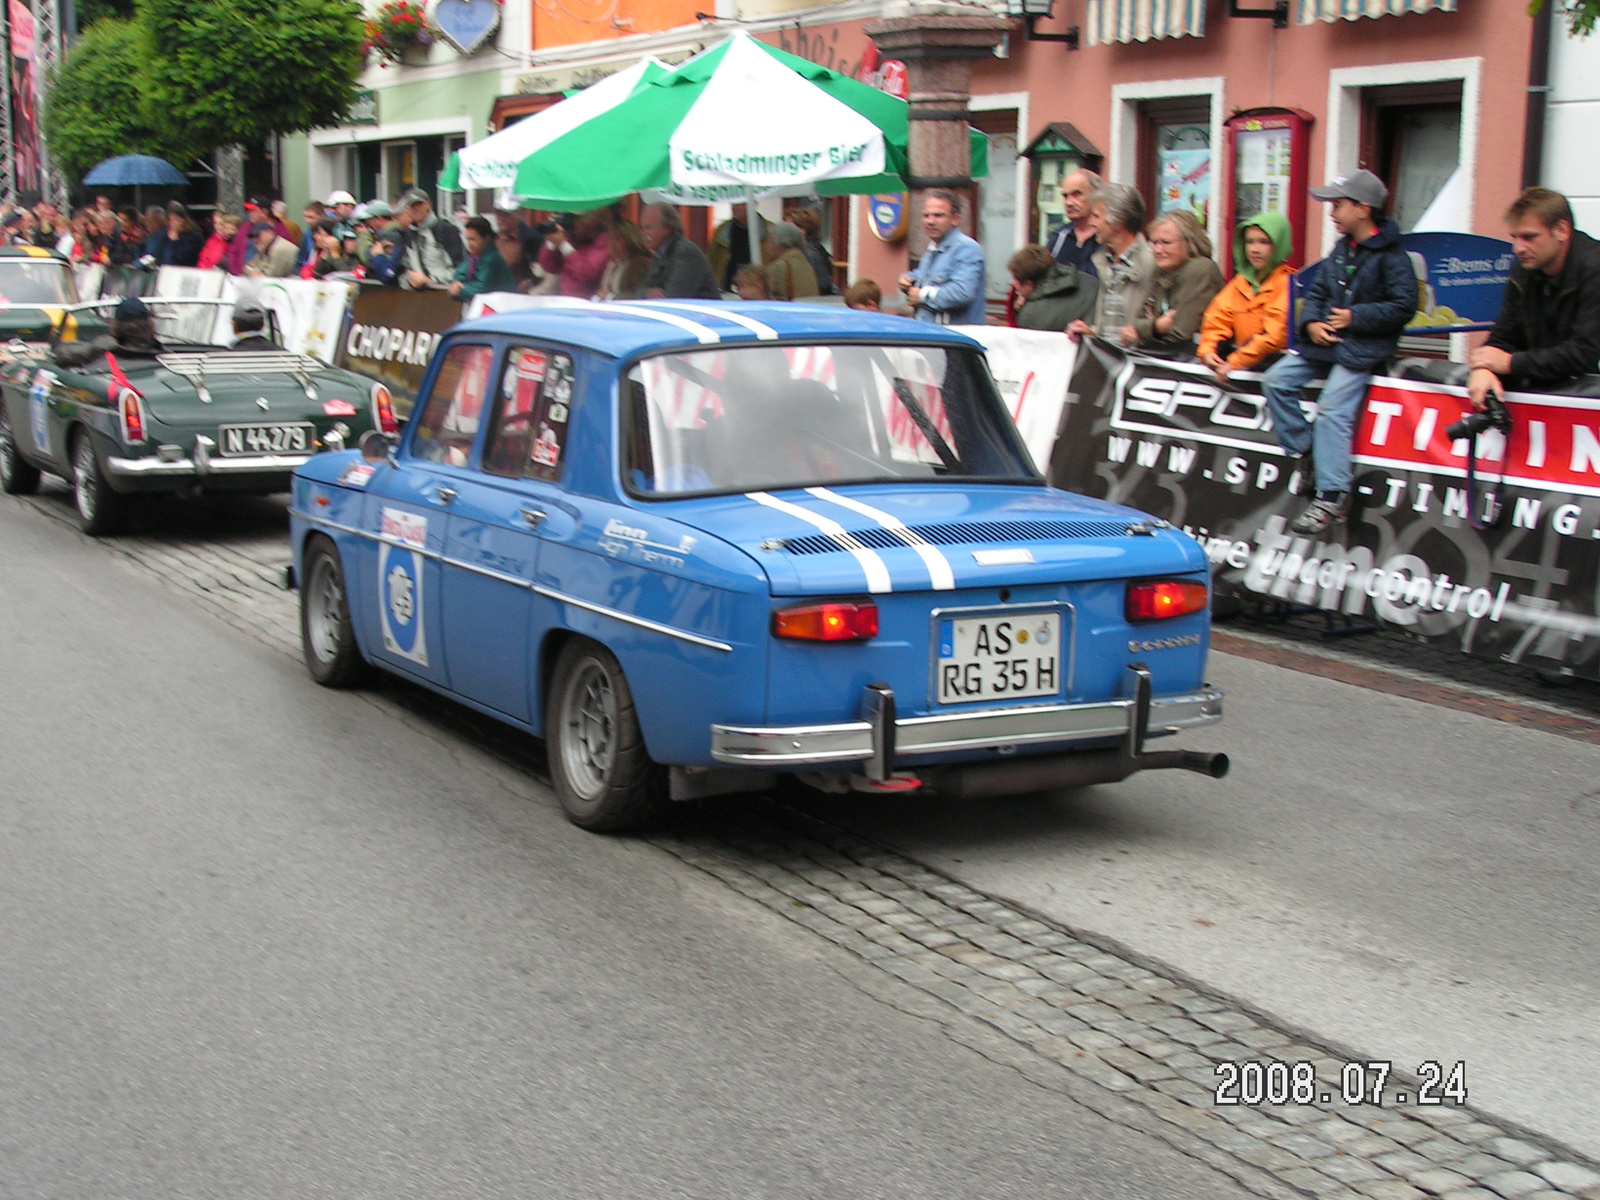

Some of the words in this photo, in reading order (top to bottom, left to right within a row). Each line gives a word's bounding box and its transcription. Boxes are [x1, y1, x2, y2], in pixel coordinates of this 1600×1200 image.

[683, 149, 821, 175] Schladminger
[828, 144, 868, 165] Bier
[227, 428, 243, 453] N
[1364, 567, 1511, 622] control
[974, 622, 1013, 656] AS
[944, 663, 983, 697] RG
[992, 659, 1028, 692] 35
[1036, 656, 1054, 690] H
